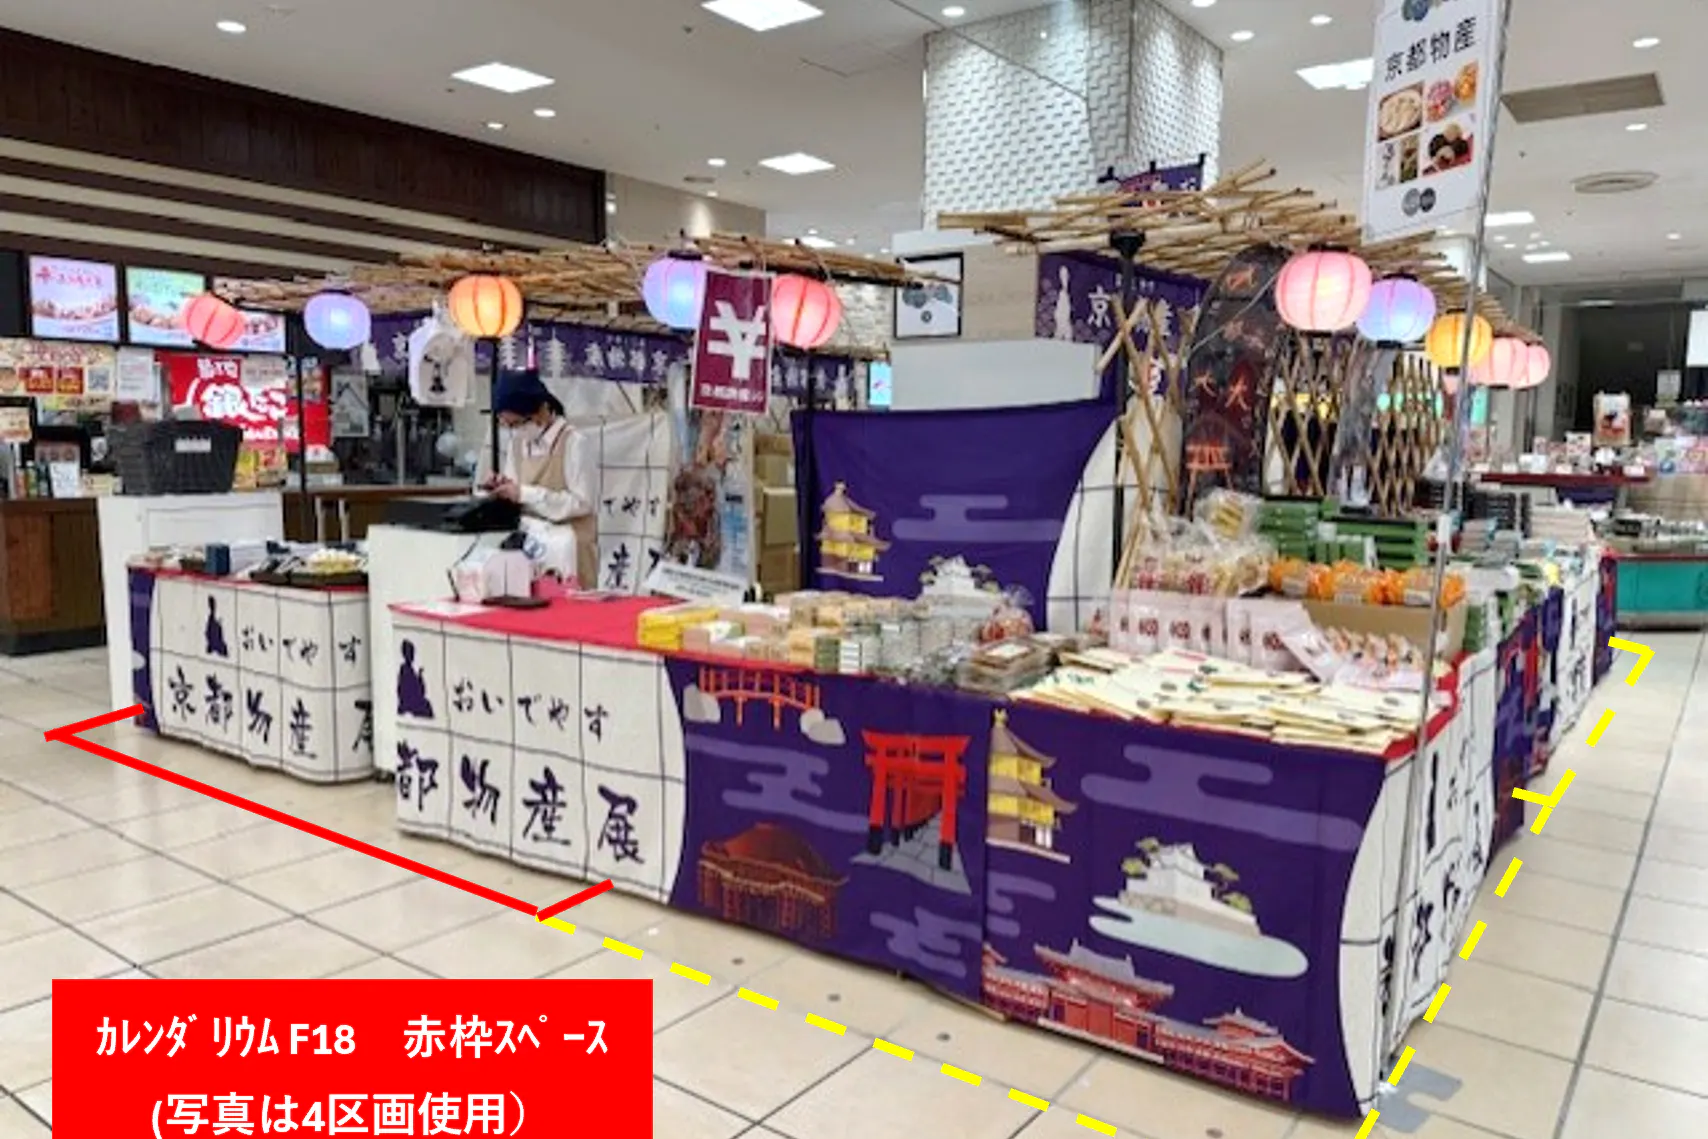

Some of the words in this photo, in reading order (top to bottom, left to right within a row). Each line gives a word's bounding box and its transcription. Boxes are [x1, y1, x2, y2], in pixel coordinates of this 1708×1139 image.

[1385, 17, 1476, 82] 京都物産
[242, 623, 362, 667] おいでやす
[453, 677, 609, 743] おいでやす
[397, 739, 645, 864] 都物産展
